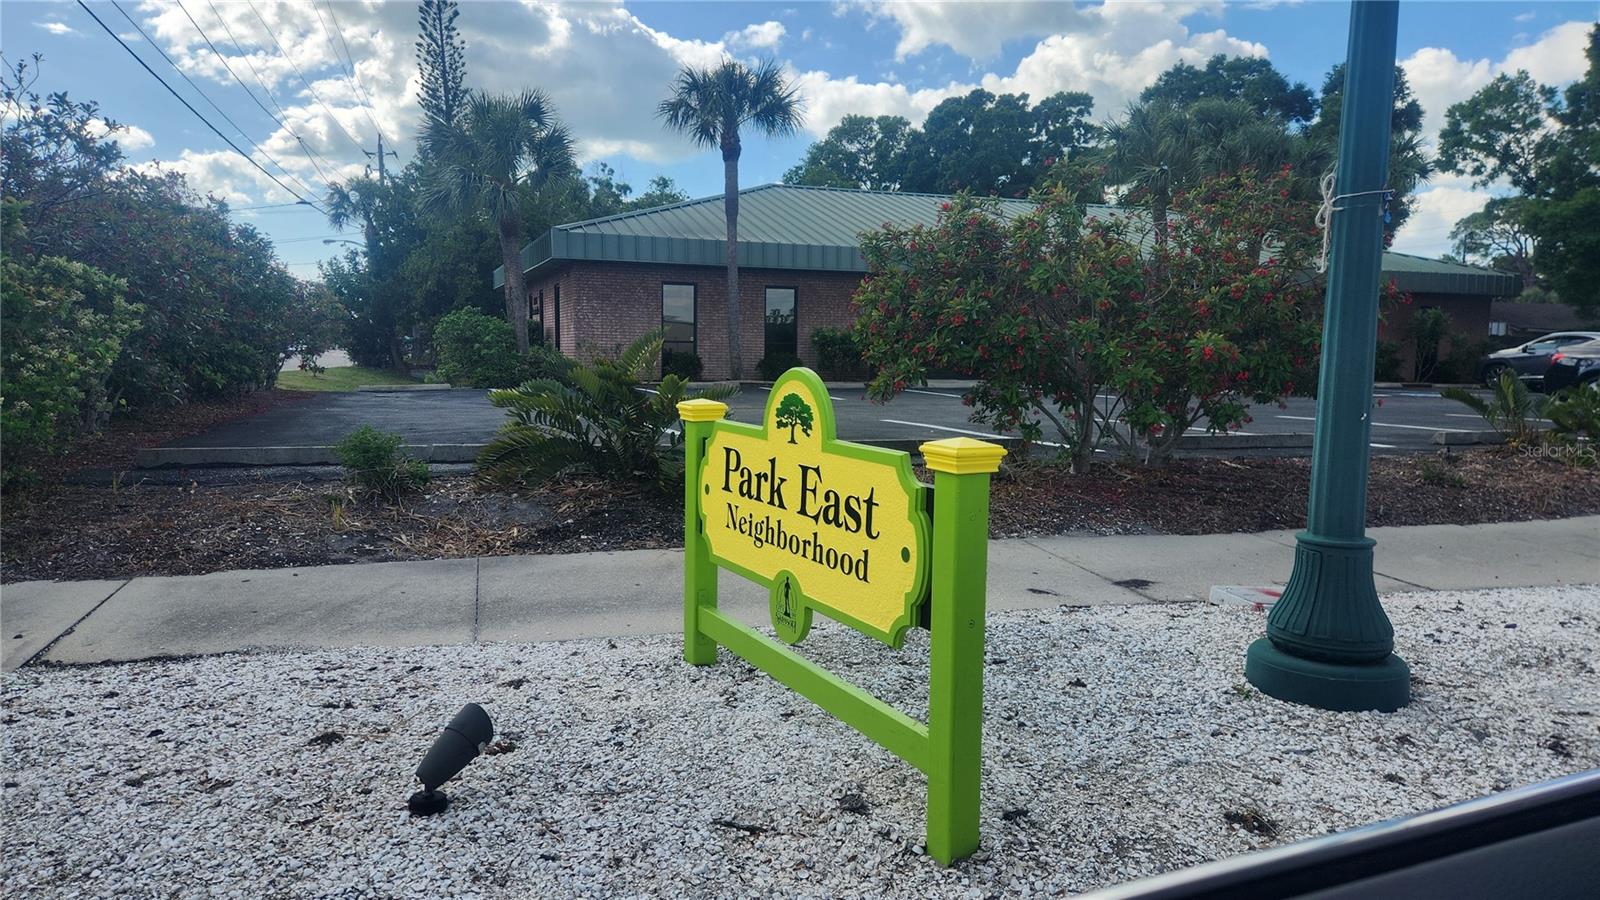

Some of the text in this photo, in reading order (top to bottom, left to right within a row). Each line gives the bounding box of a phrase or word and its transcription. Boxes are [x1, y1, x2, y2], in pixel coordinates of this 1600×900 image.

[721, 446, 880, 540] Park East
[725, 502, 870, 584] Neighborhood
